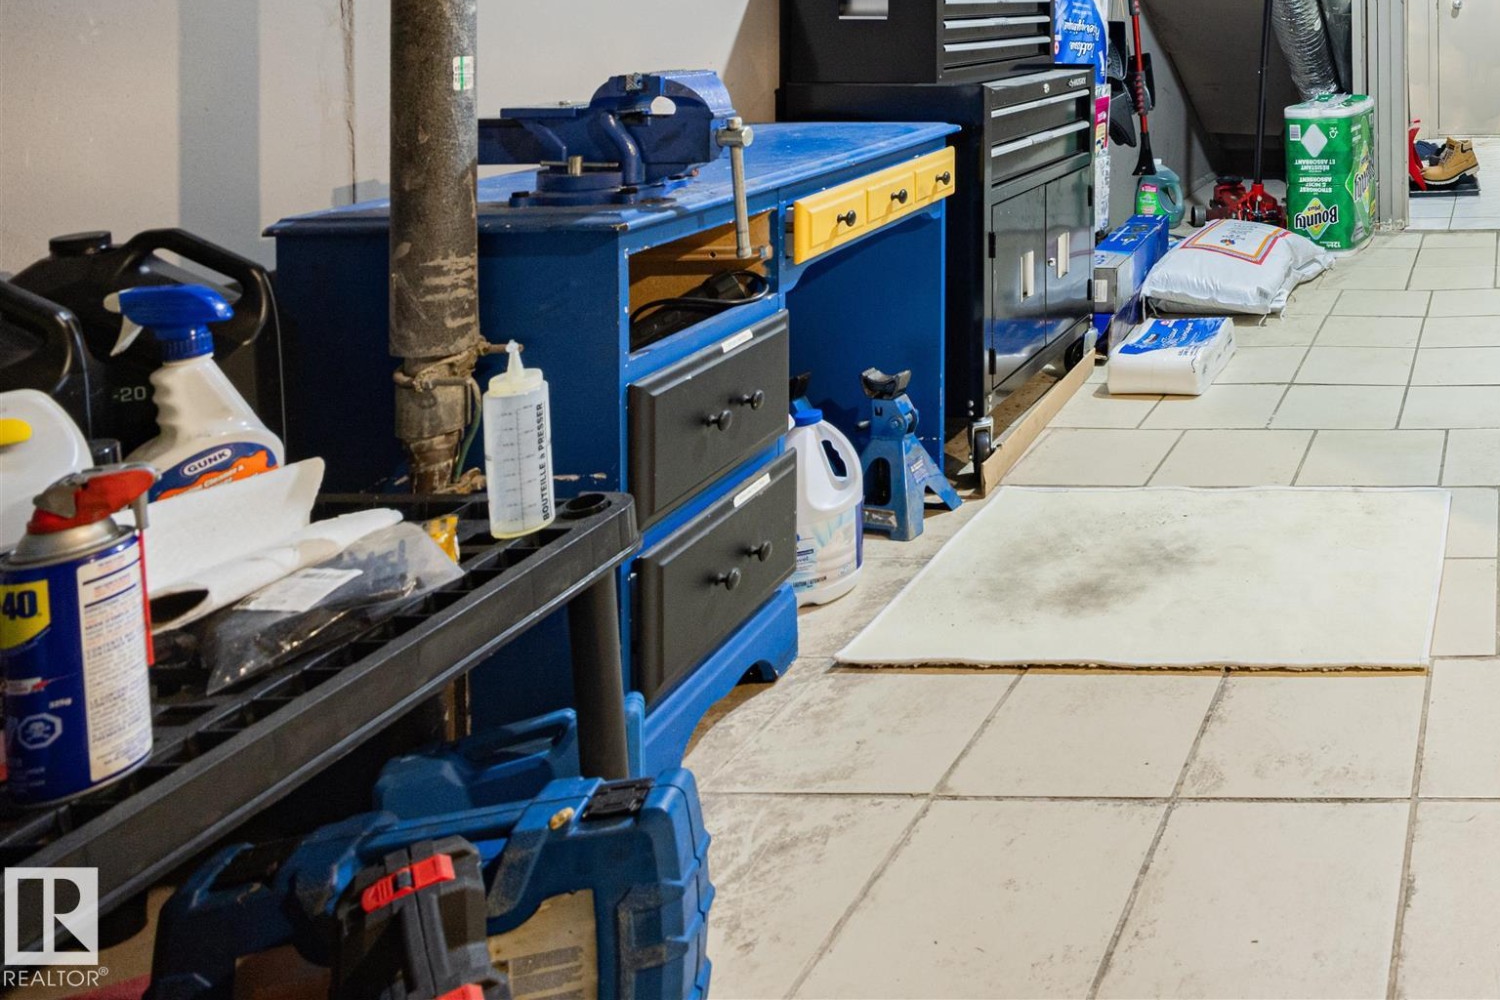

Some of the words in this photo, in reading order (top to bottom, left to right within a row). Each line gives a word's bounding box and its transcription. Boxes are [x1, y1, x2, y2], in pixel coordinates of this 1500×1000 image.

[1294, 204, 1339, 231] Bounty
[535, 402, 545, 451] PRESSER
[186, 449, 230, 474] GUNK
[538, 463, 550, 521] BOUTEILLE
